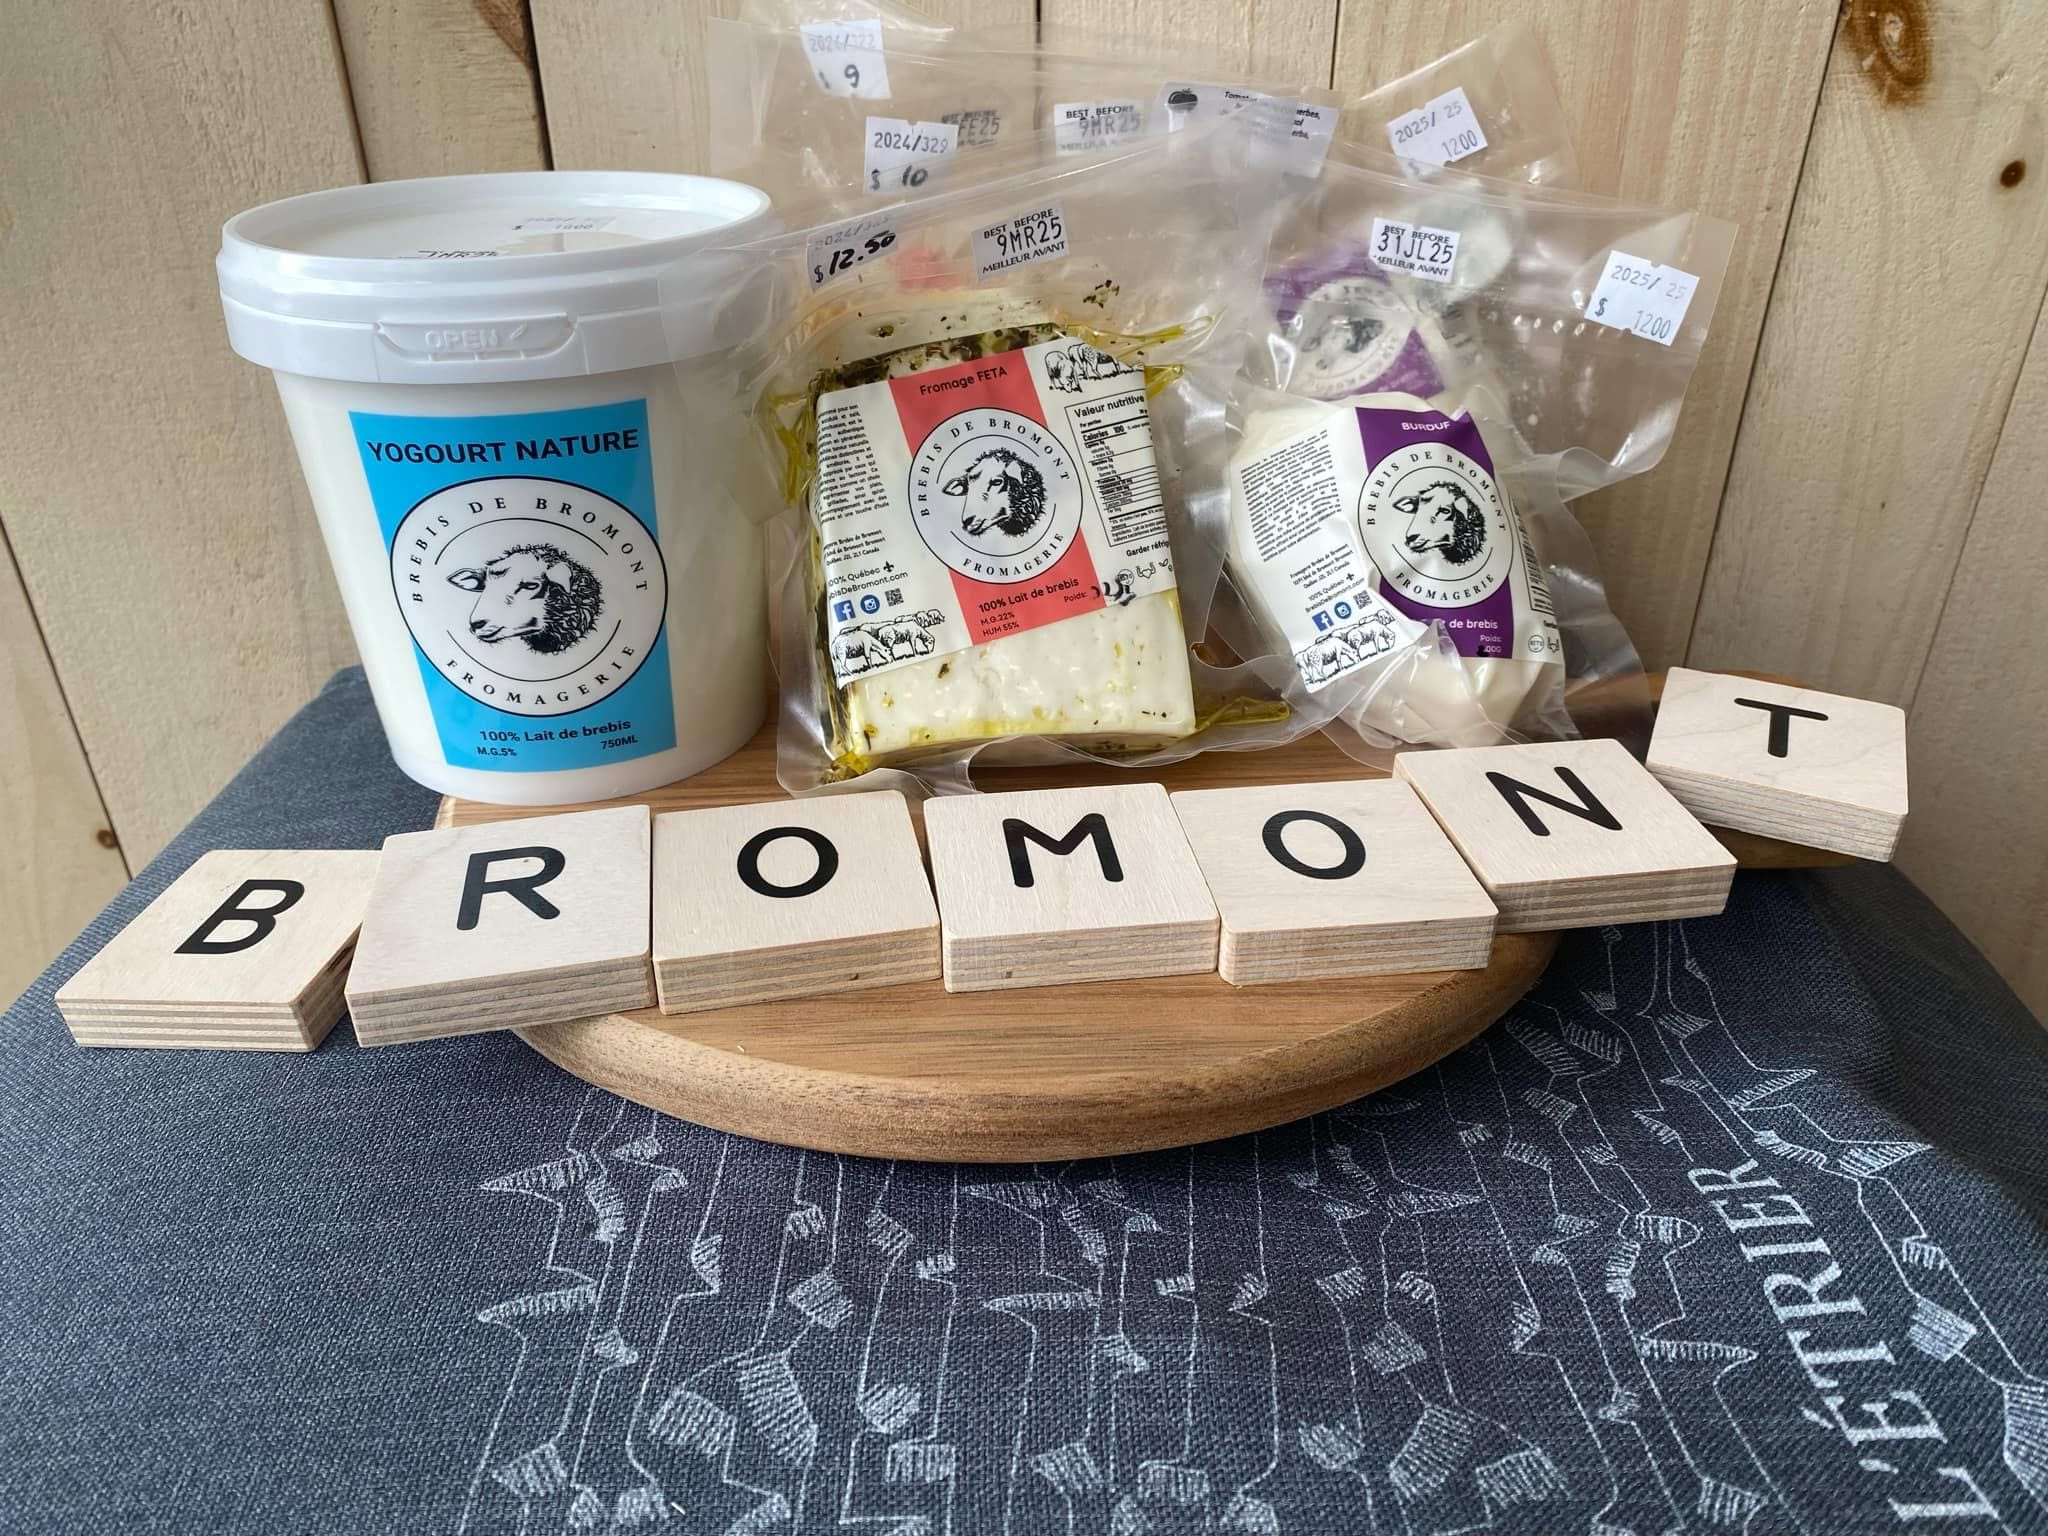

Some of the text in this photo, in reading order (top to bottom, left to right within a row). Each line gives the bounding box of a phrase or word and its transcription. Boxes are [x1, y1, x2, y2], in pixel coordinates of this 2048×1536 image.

[844, 64, 860, 88] 9
[1066, 109, 1088, 120] BEST
[1441, 129, 1478, 158] 1200
[902, 165, 928, 187] 10
[984, 208, 1054, 240] BEST BEFORE
[997, 216, 1062, 257] 9MR25
[1384, 225, 1451, 245] BEST BEFORE
[829, 230, 897, 276] 12.50
[982, 240, 1066, 274] MEILLEUR AVANT
[1377, 231, 1454, 265] 31JL25
[1416, 264, 1449, 277] AVANT
[1611, 265, 1662, 291] 2025/
[424, 329, 499, 348] OPEN
[1633, 310, 1672, 340] 1200
[919, 366, 1008, 396] Fromage FETA
[1074, 395, 1145, 418] Valeur nutritive
[366, 428, 640, 464] YOGOURT NATURE
[917, 442, 943, 518] BREBIS
[950, 420, 974, 439] DE
[989, 417, 1070, 481] BROMONT
[1367, 462, 1400, 526] BREBIS
[1409, 451, 1433, 463] DE
[1446, 454, 1506, 531] BROMONT
[410, 496, 648, 603] BREBIS DE BROMONT
[963, 533, 1064, 577] FROMAGERIE
[1126, 545, 1150, 557] Garder
[828, 567, 881, 587] 00% Québec
[1394, 572, 1494, 601] FROMAGERIE
[978, 598, 1007, 613] 100%
[1008, 591, 1028, 605] Lait
[1030, 586, 1044, 598] de
[1047, 578, 1080, 594] brebis
[983, 621, 1020, 637] HUM 55%
[1449, 619, 1463, 629] de
[1466, 619, 1499, 629] brebis
[446, 645, 635, 706] FROMAGERIE
[480, 719, 632, 742] 100% Lait de brebis
[477, 734, 640, 757] M.G.5% 750ML
